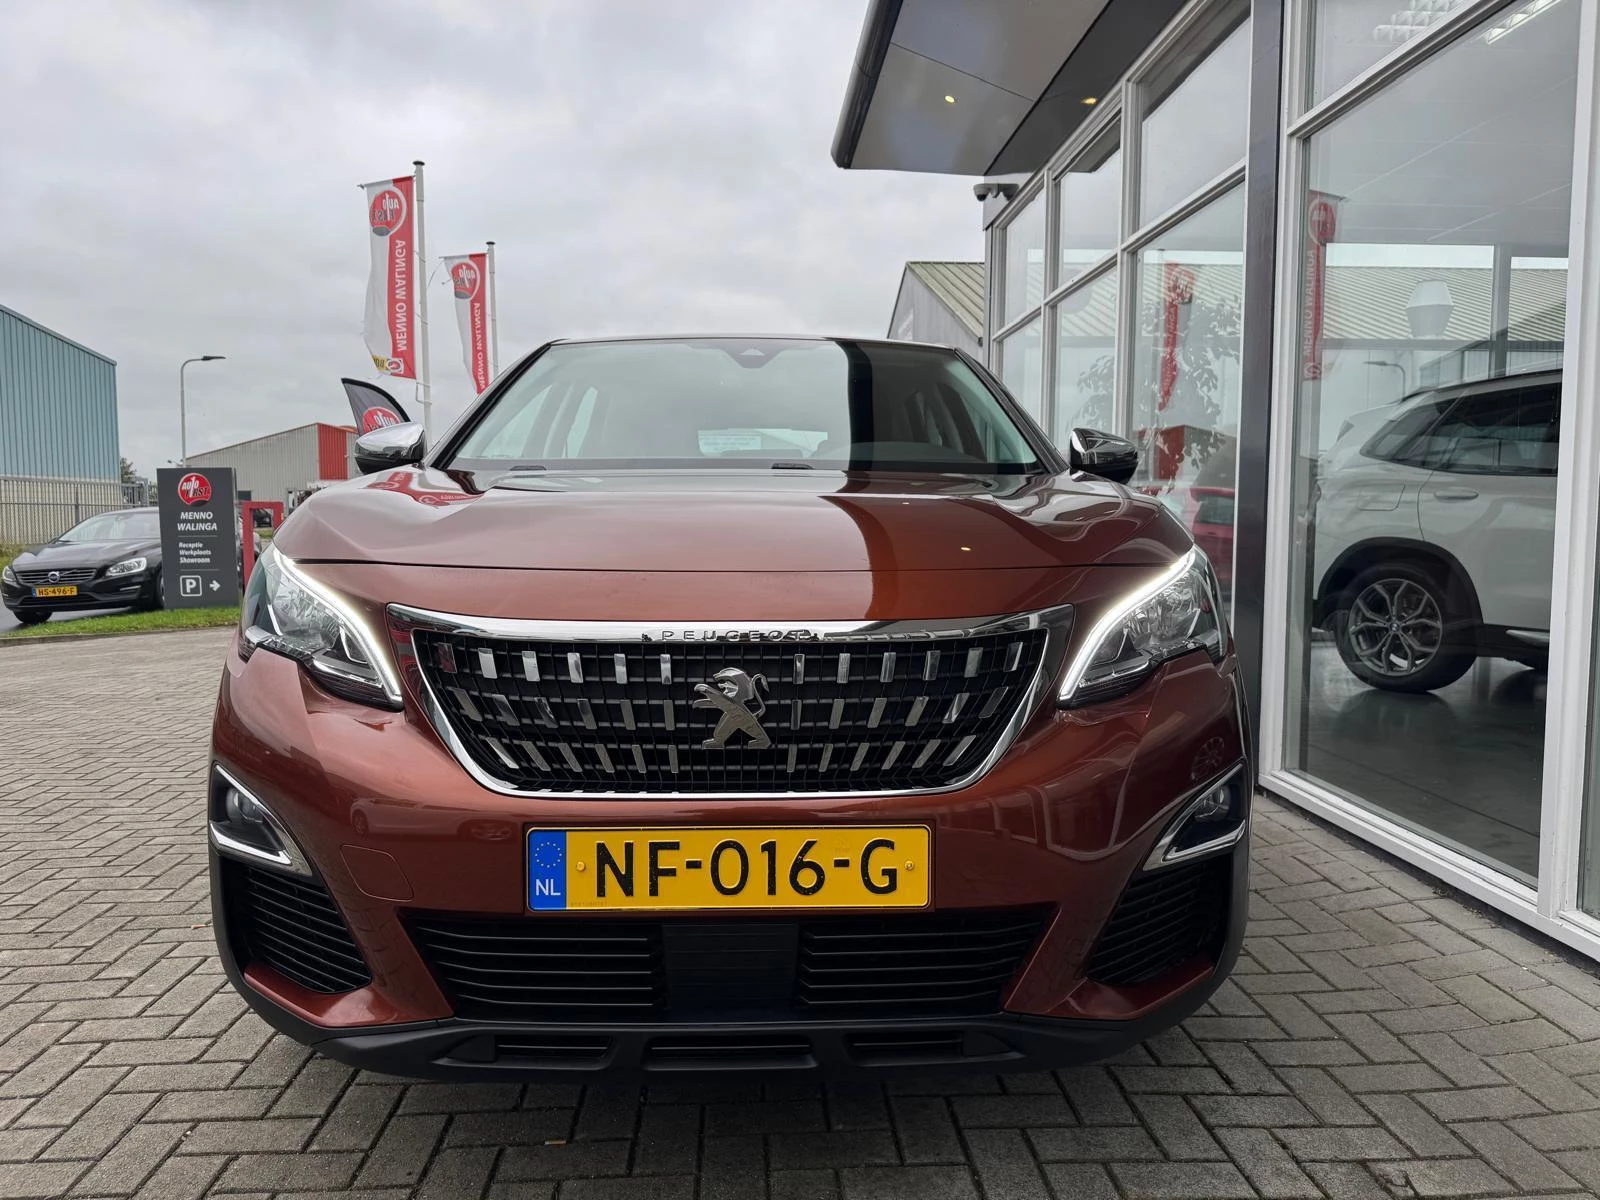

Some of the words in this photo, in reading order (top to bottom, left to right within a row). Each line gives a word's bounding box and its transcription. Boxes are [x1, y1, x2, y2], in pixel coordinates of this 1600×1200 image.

[180, 511, 214, 520] MENNO
[177, 522, 218, 531] WALINGA
[38, 587, 75, 596] HS-496-F
[661, 630, 805, 642] PEUGEOT
[595, 837, 898, 898] NF-016-G
[535, 878, 561, 896] NL
